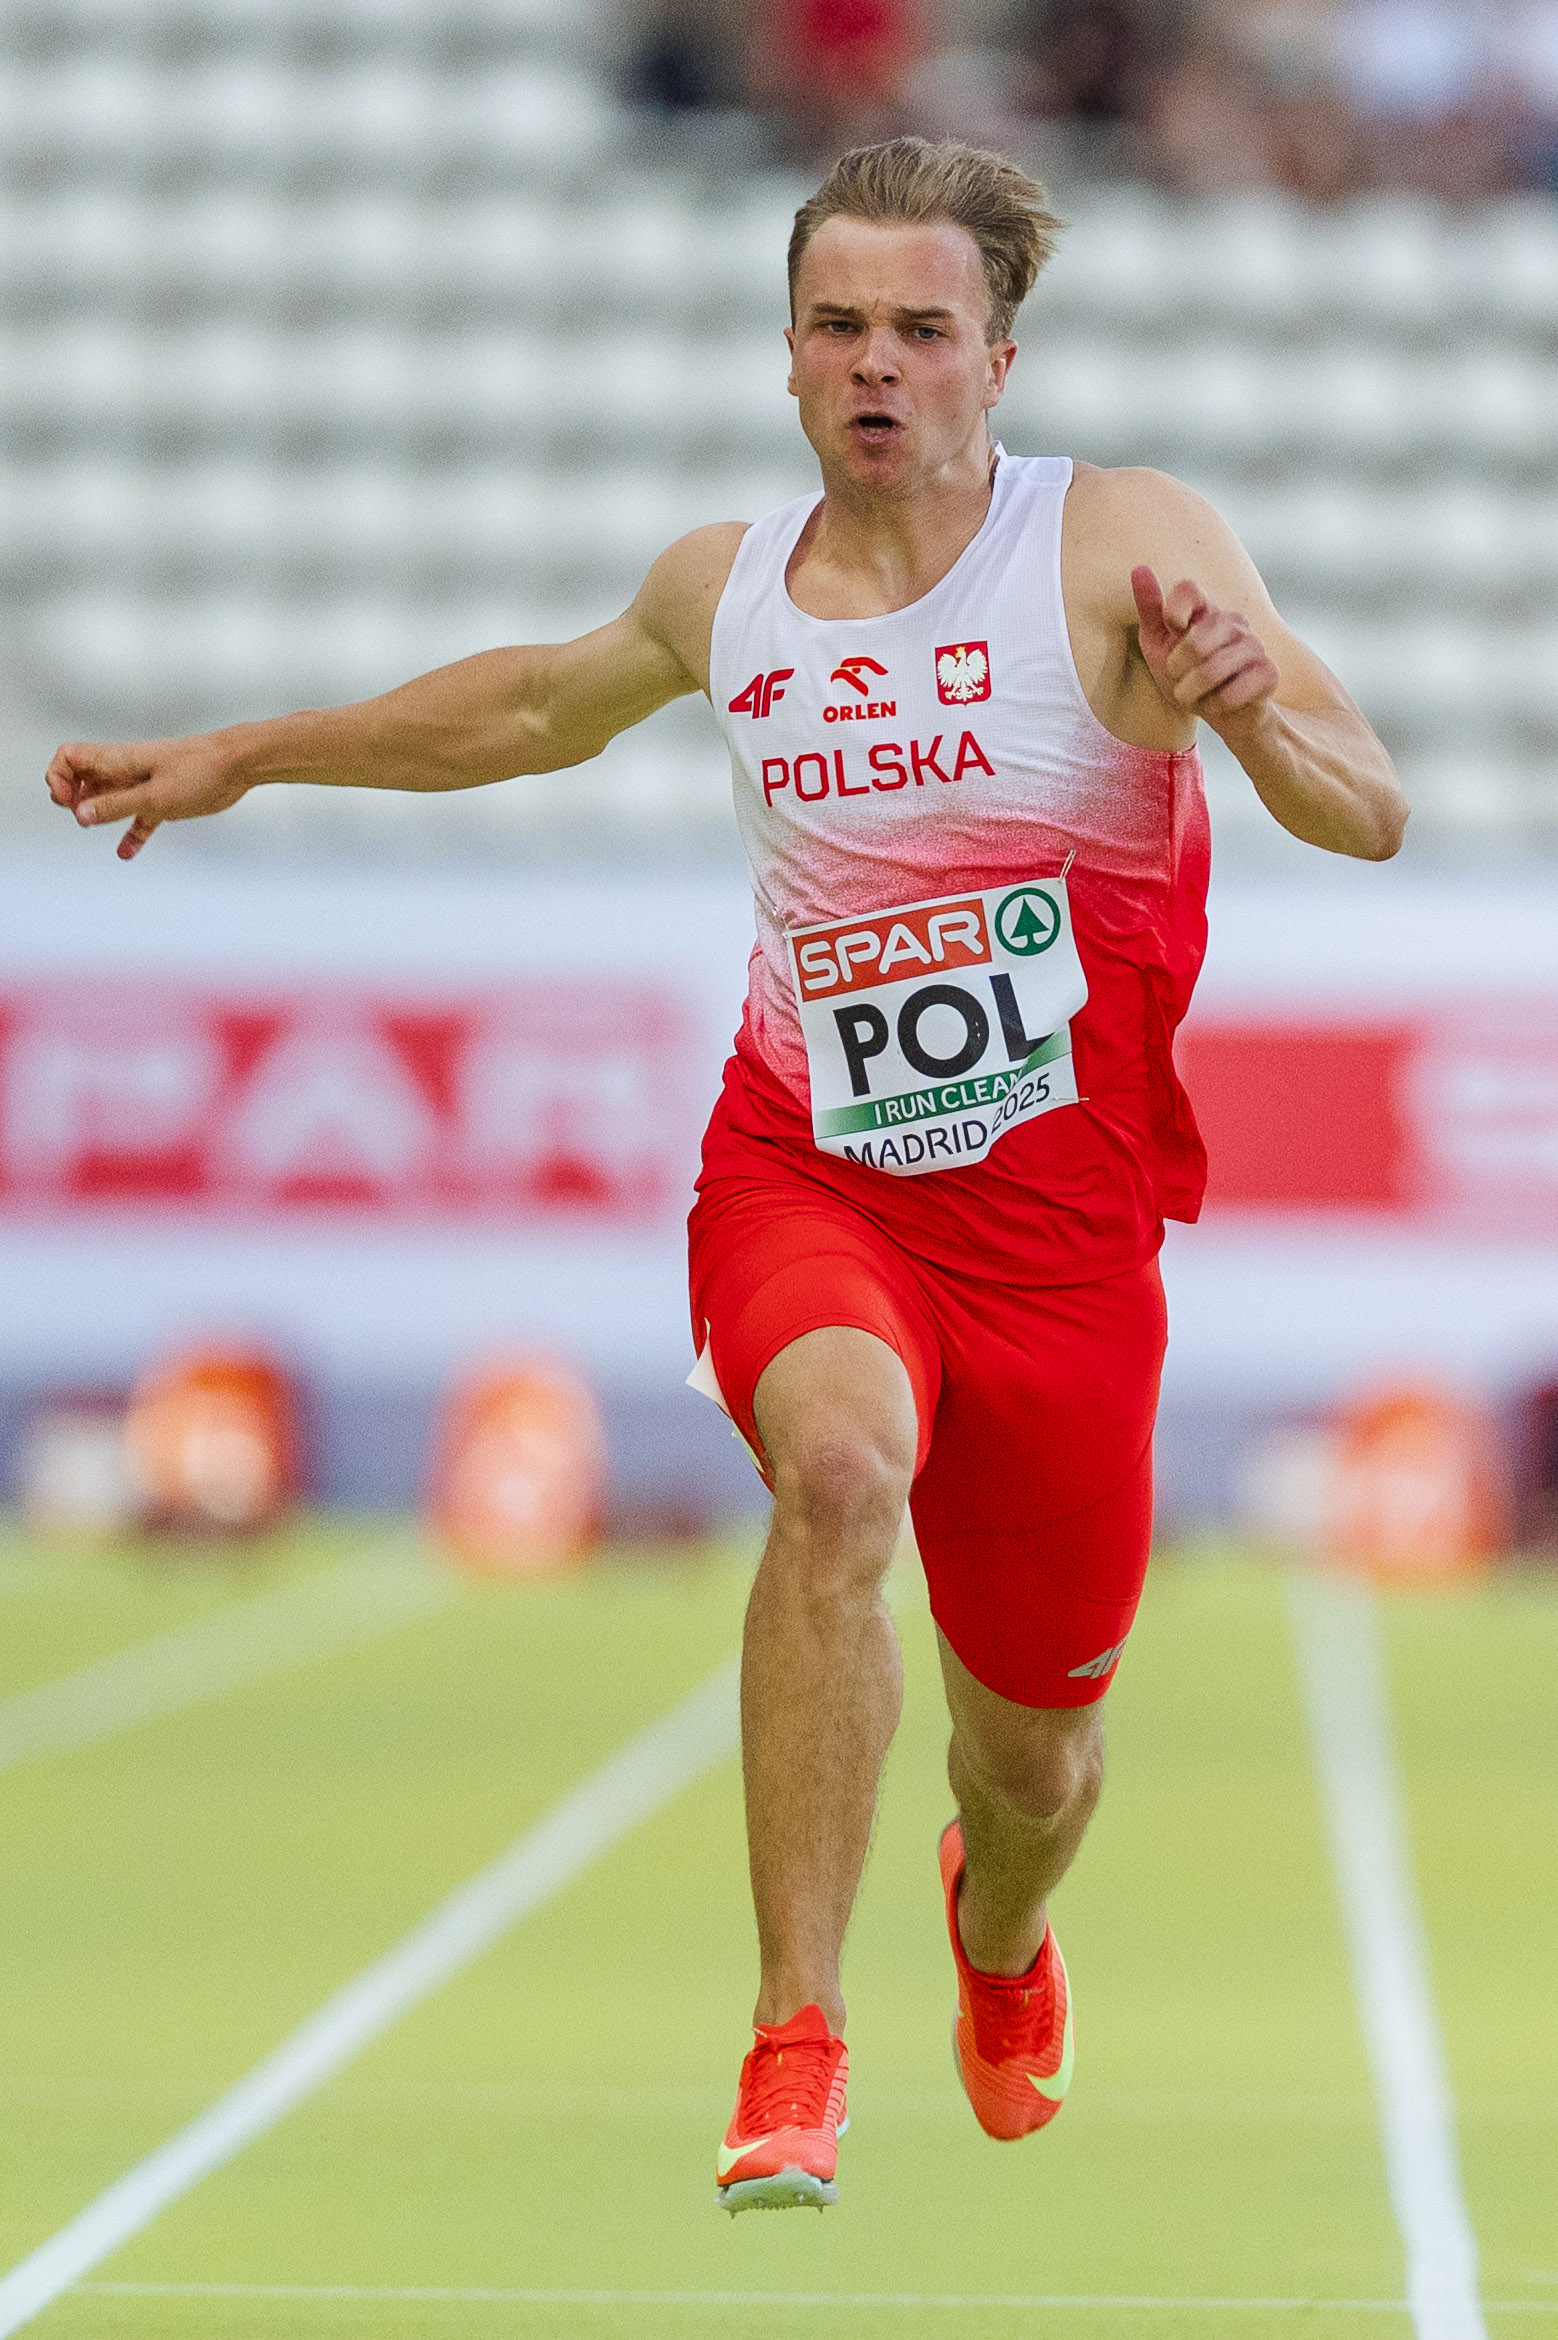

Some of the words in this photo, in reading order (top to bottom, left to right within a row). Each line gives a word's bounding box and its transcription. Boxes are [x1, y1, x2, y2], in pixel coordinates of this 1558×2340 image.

[728, 668, 795, 719] 4F
[822, 701, 897, 723] ORLEN
[761, 730, 996, 808] POLSKA
[800, 909, 984, 991] SPAR
[833, 972, 1055, 1097] POL
[843, 1119, 988, 1169] MADRID
[991, 1072, 1050, 1135] 2025
[874, 1103, 882, 1125] I
[885, 1091, 937, 1123] RUN
